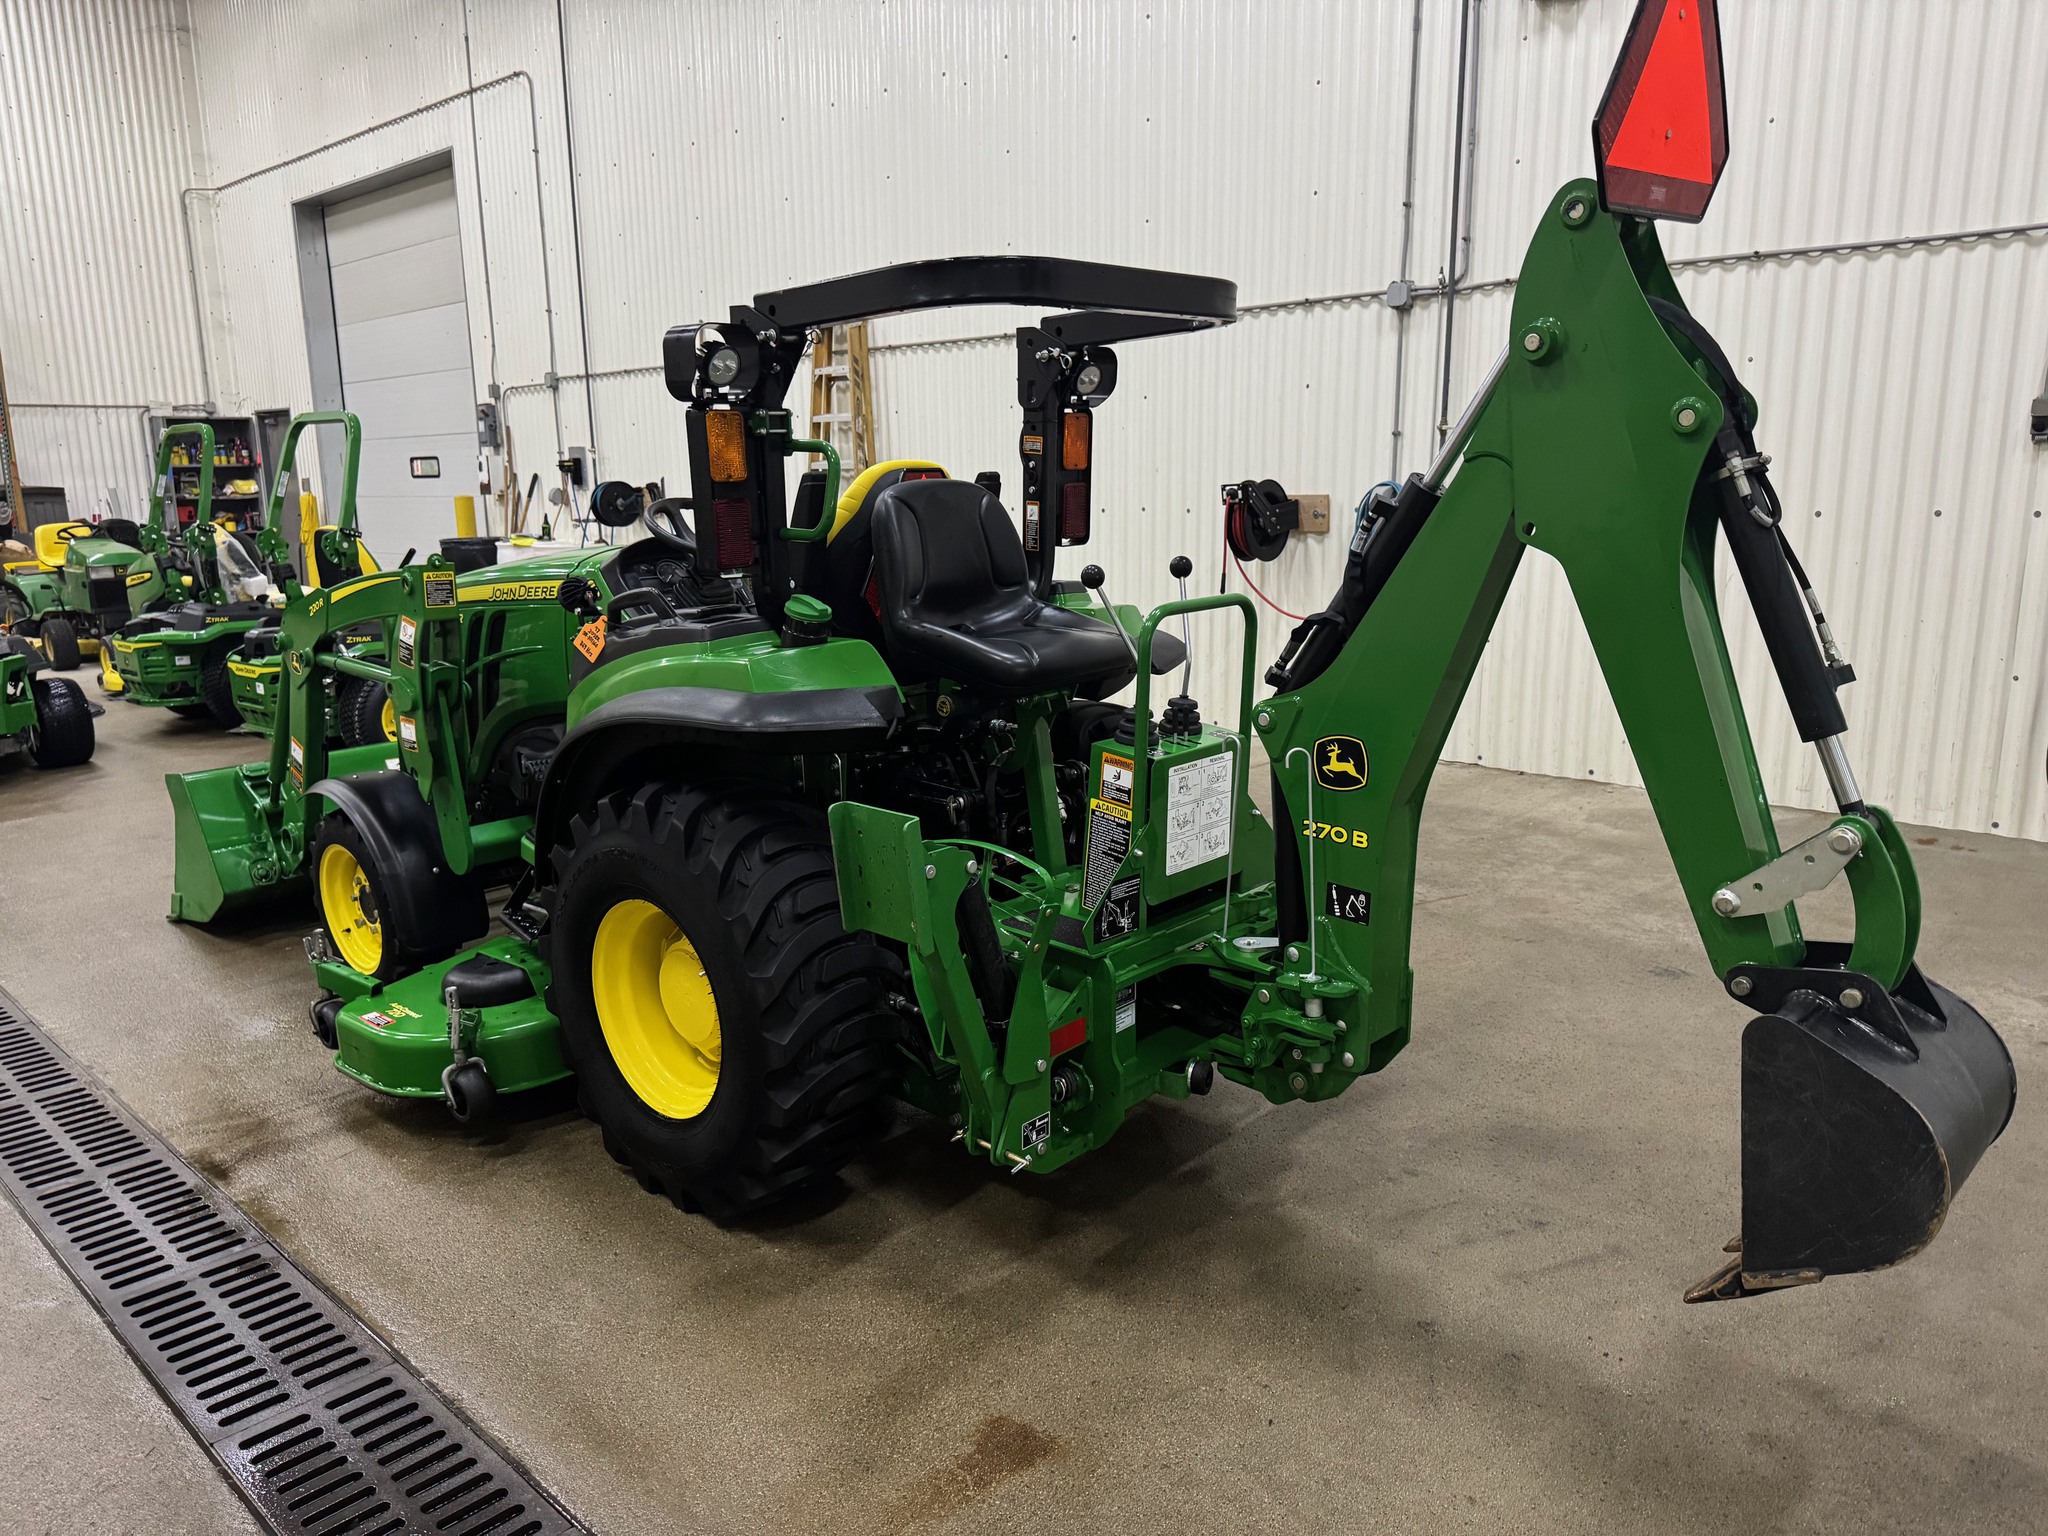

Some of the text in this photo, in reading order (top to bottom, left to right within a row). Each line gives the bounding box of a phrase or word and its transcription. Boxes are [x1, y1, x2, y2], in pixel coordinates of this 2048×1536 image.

[488, 585, 557, 601] JOHN DEERE
[205, 616, 230, 624] ZTRAK
[346, 636, 372, 644] ZTRAK
[1109, 756, 1133, 771] WARNING
[1101, 803, 1129, 819] CAUTION
[1302, 819, 1369, 849] 270 B
